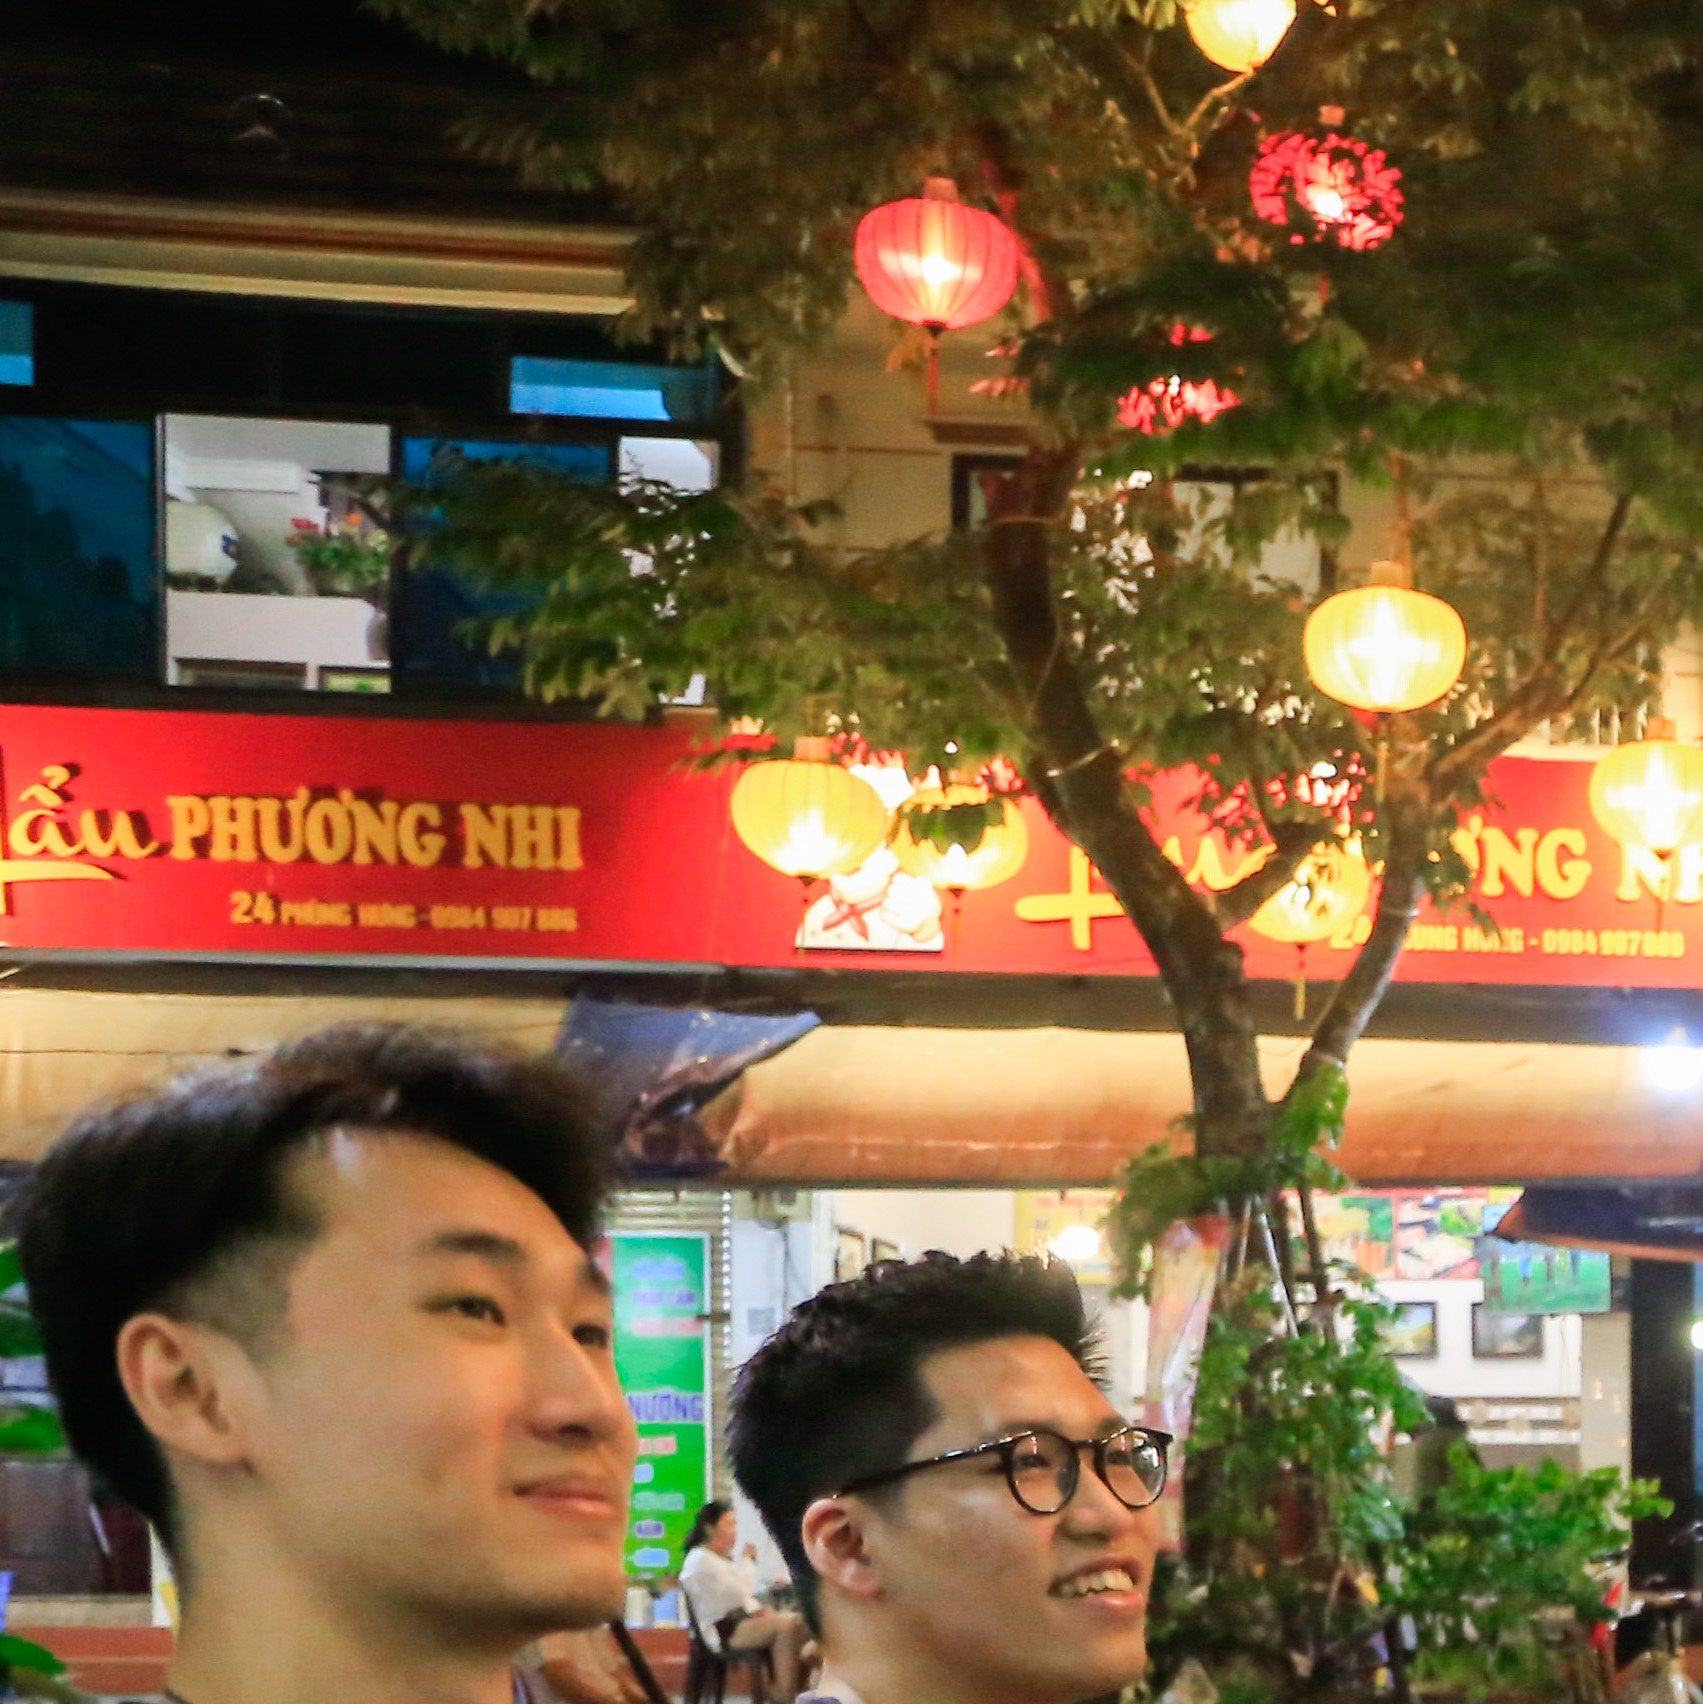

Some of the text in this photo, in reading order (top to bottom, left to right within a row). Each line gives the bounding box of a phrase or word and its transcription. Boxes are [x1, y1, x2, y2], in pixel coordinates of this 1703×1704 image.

[0, 764, 582, 880] ẩu PHƯƠNG NHI
[230, 890, 276, 924] 24
